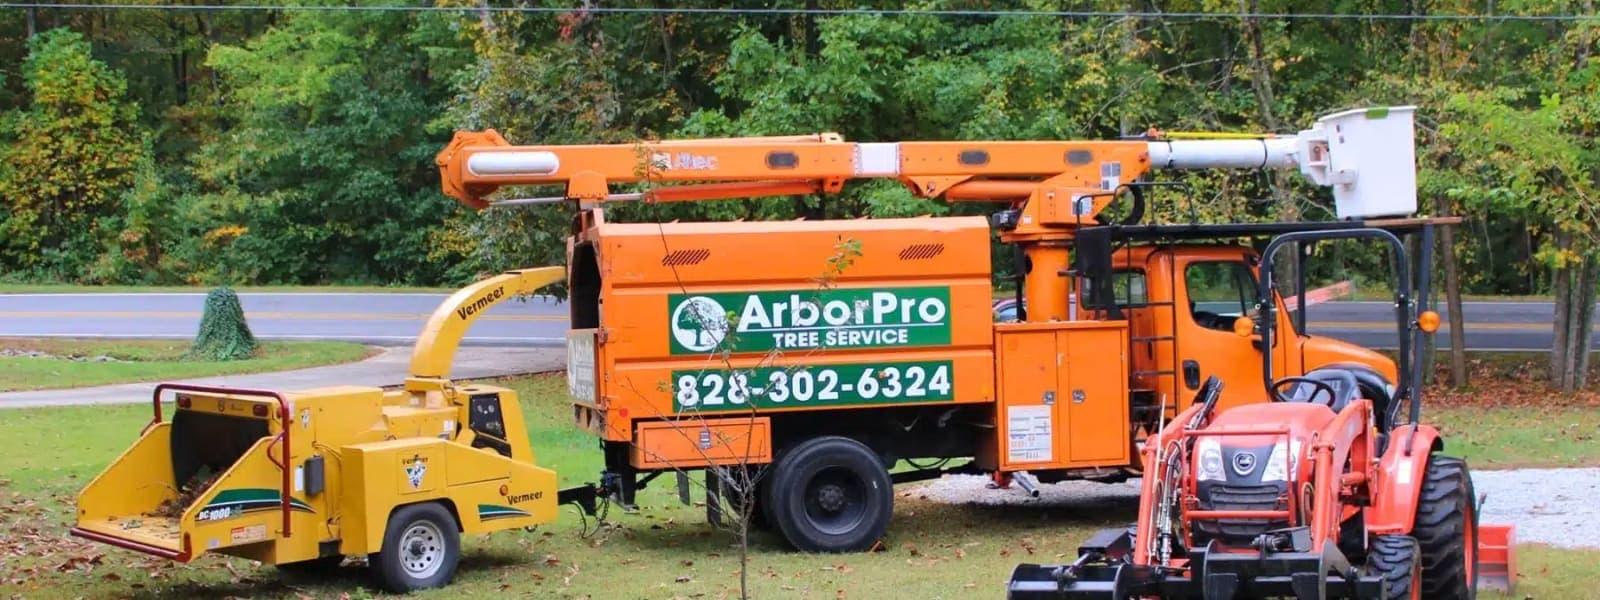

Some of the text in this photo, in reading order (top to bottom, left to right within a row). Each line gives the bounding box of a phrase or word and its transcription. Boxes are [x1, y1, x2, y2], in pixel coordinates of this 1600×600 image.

[457, 286, 505, 320] Vermeer
[737, 292, 946, 331] ArborPro
[772, 329, 909, 348] TREE SERVICE
[677, 365, 951, 406] 828-302-6324
[506, 491, 543, 505] Vermeer
